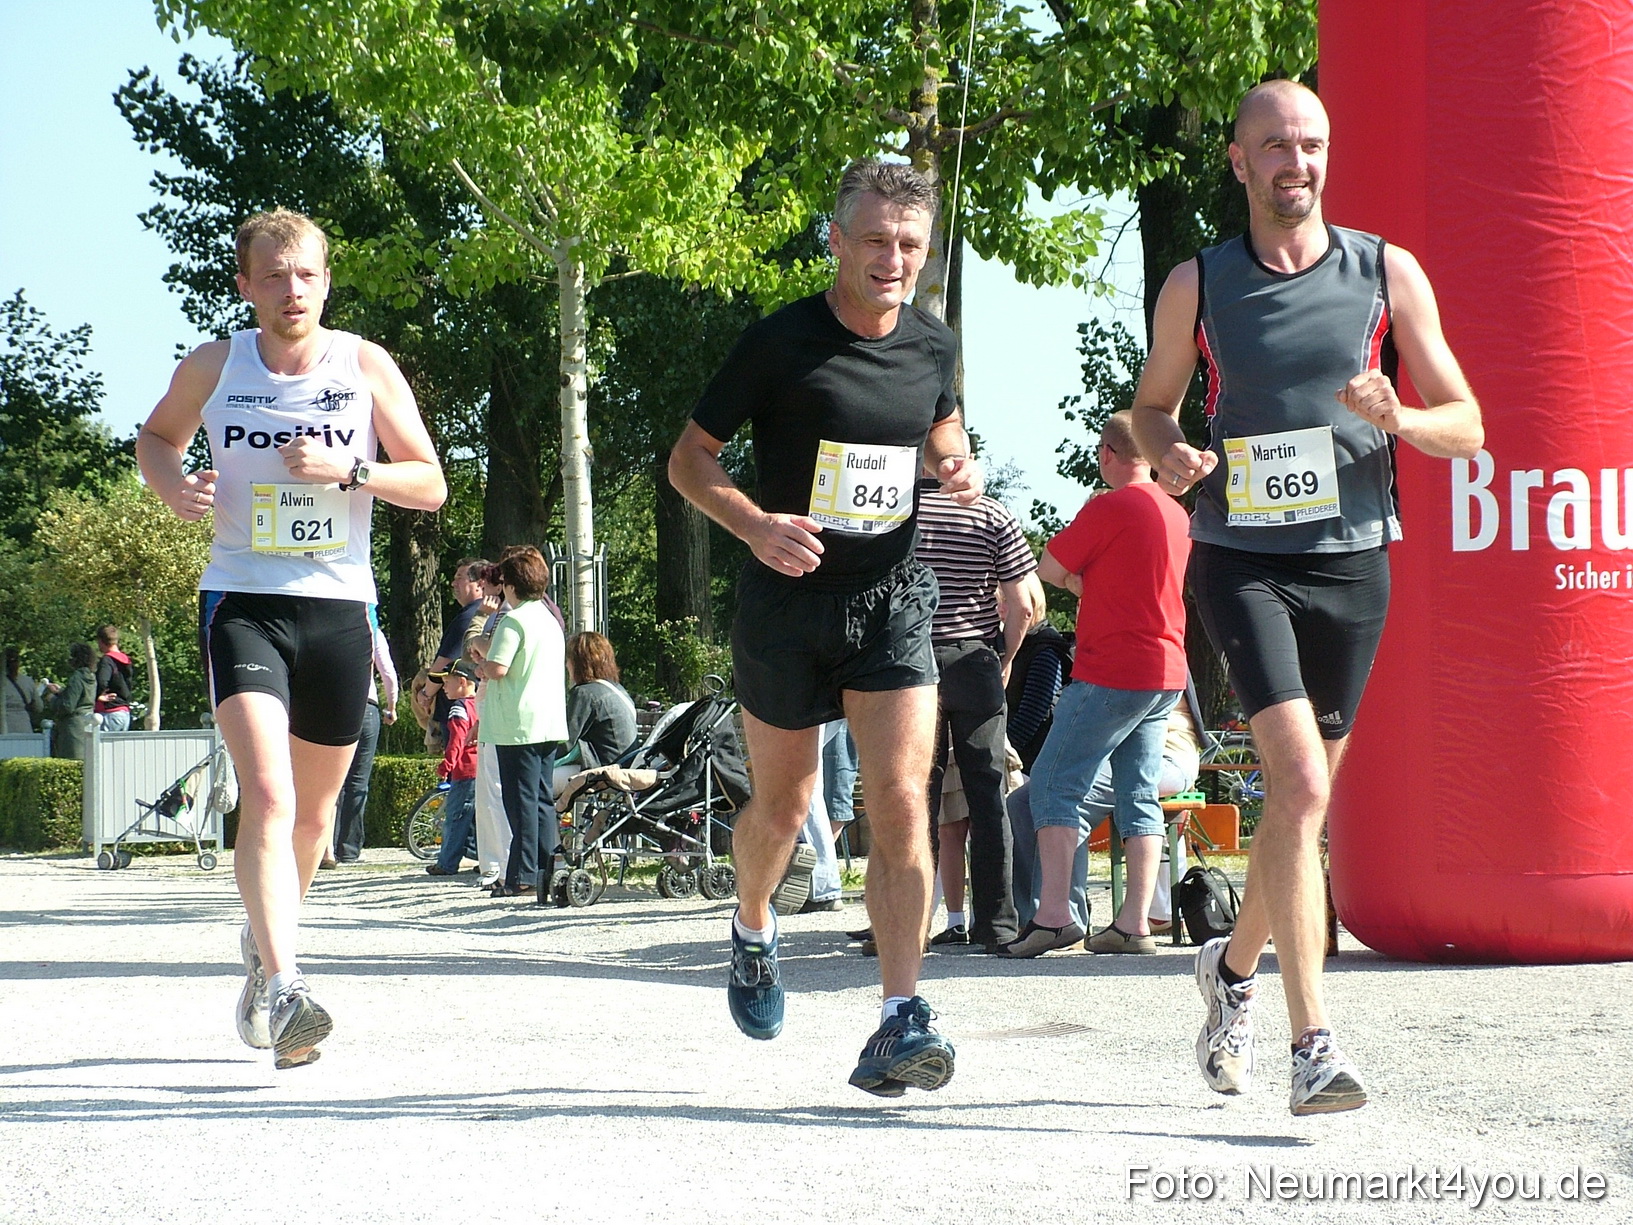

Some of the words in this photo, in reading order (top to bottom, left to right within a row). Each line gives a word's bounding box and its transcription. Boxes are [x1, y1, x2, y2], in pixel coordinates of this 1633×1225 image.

[227, 395, 278, 404] POSITIV
[1251, 442, 1297, 462] Martin
[846, 453, 887, 470] Rudolf
[818, 474, 826, 486] B
[1231, 473, 1239, 486] B
[1265, 470, 1319, 501] 669
[280, 491, 314, 507] Alwin
[853, 485, 898, 509] 843
[1451, 447, 1633, 552] Brau
[1296, 503, 1339, 517] PFLEIDERER
[257, 514, 264, 526] B
[291, 517, 333, 542] 621
[1555, 561, 1621, 590] Sicher
